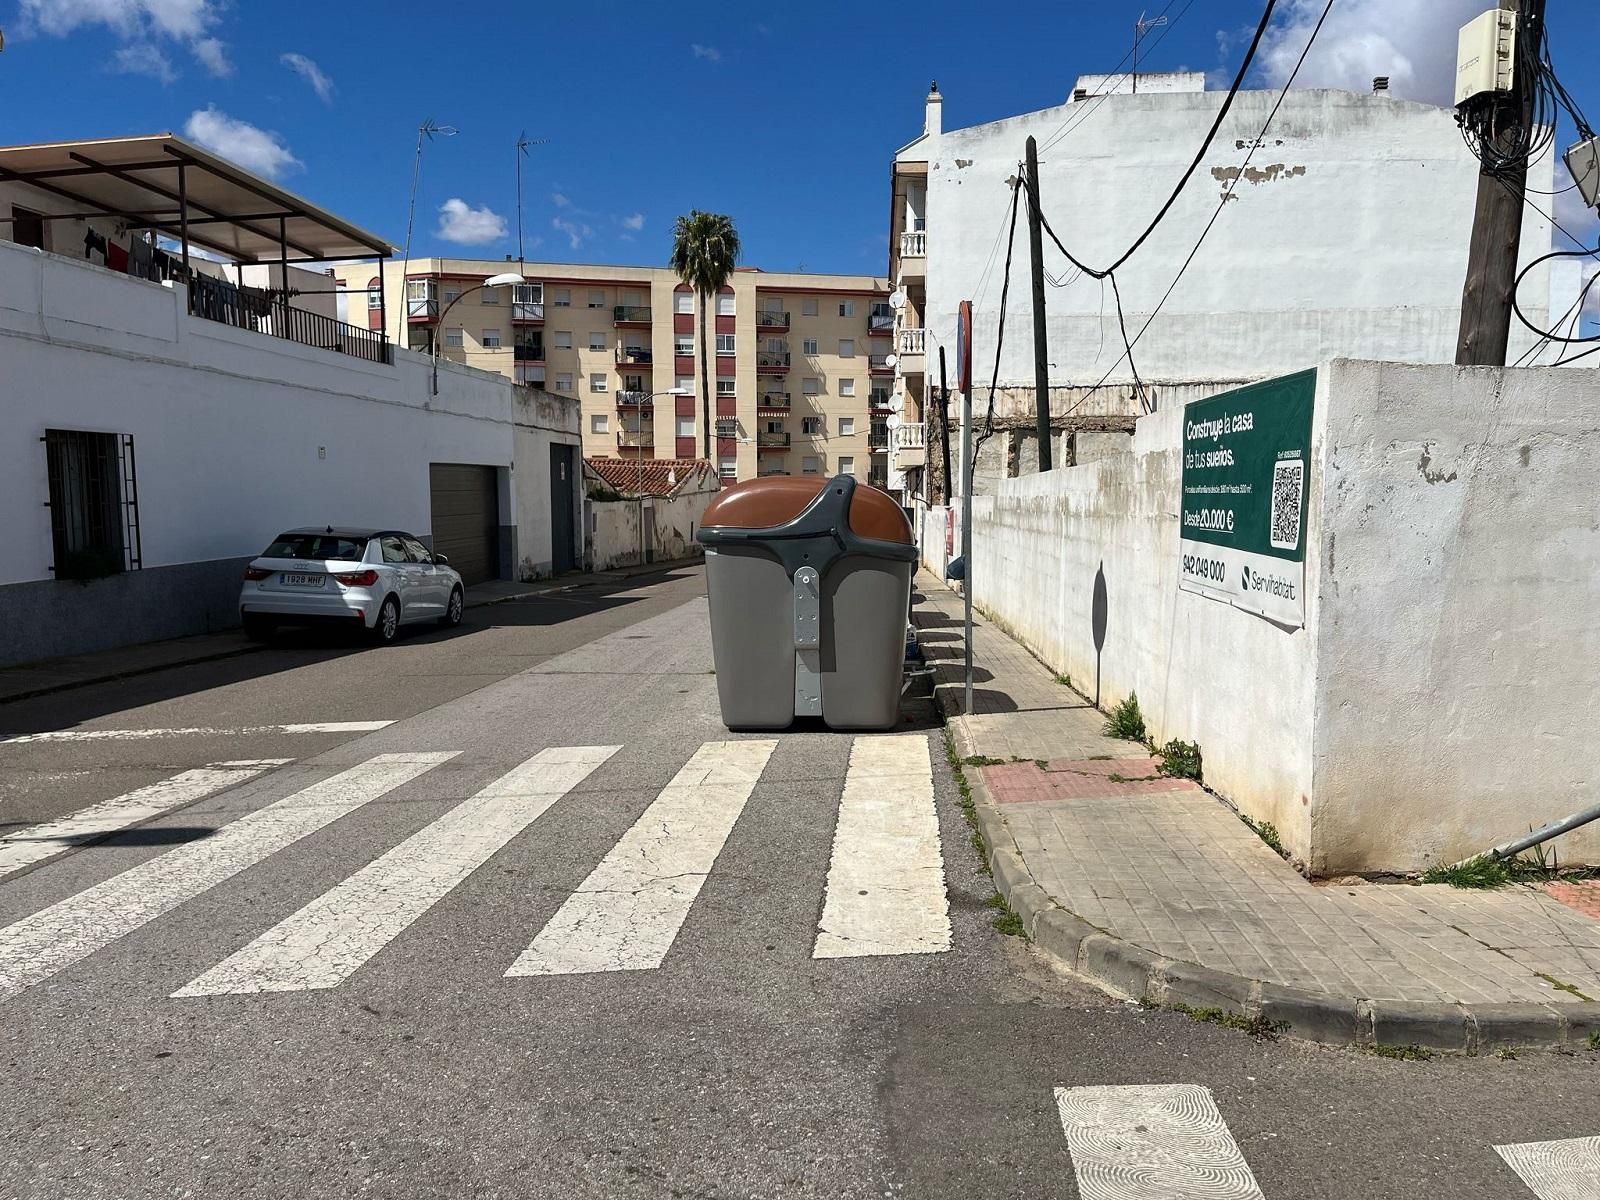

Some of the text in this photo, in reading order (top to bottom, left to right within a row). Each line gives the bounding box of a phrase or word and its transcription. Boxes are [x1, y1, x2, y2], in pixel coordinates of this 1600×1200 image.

[1186, 411, 1253, 442] Construye la casa
[1186, 449, 1194, 469] de
[1195, 450, 1205, 469] tus
[1184, 508, 1234, 531] Desde 20.000 €
[286, 575, 306, 584] 1928
[1195, 556, 1209, 579] 049
[1209, 559, 1226, 583] 000
